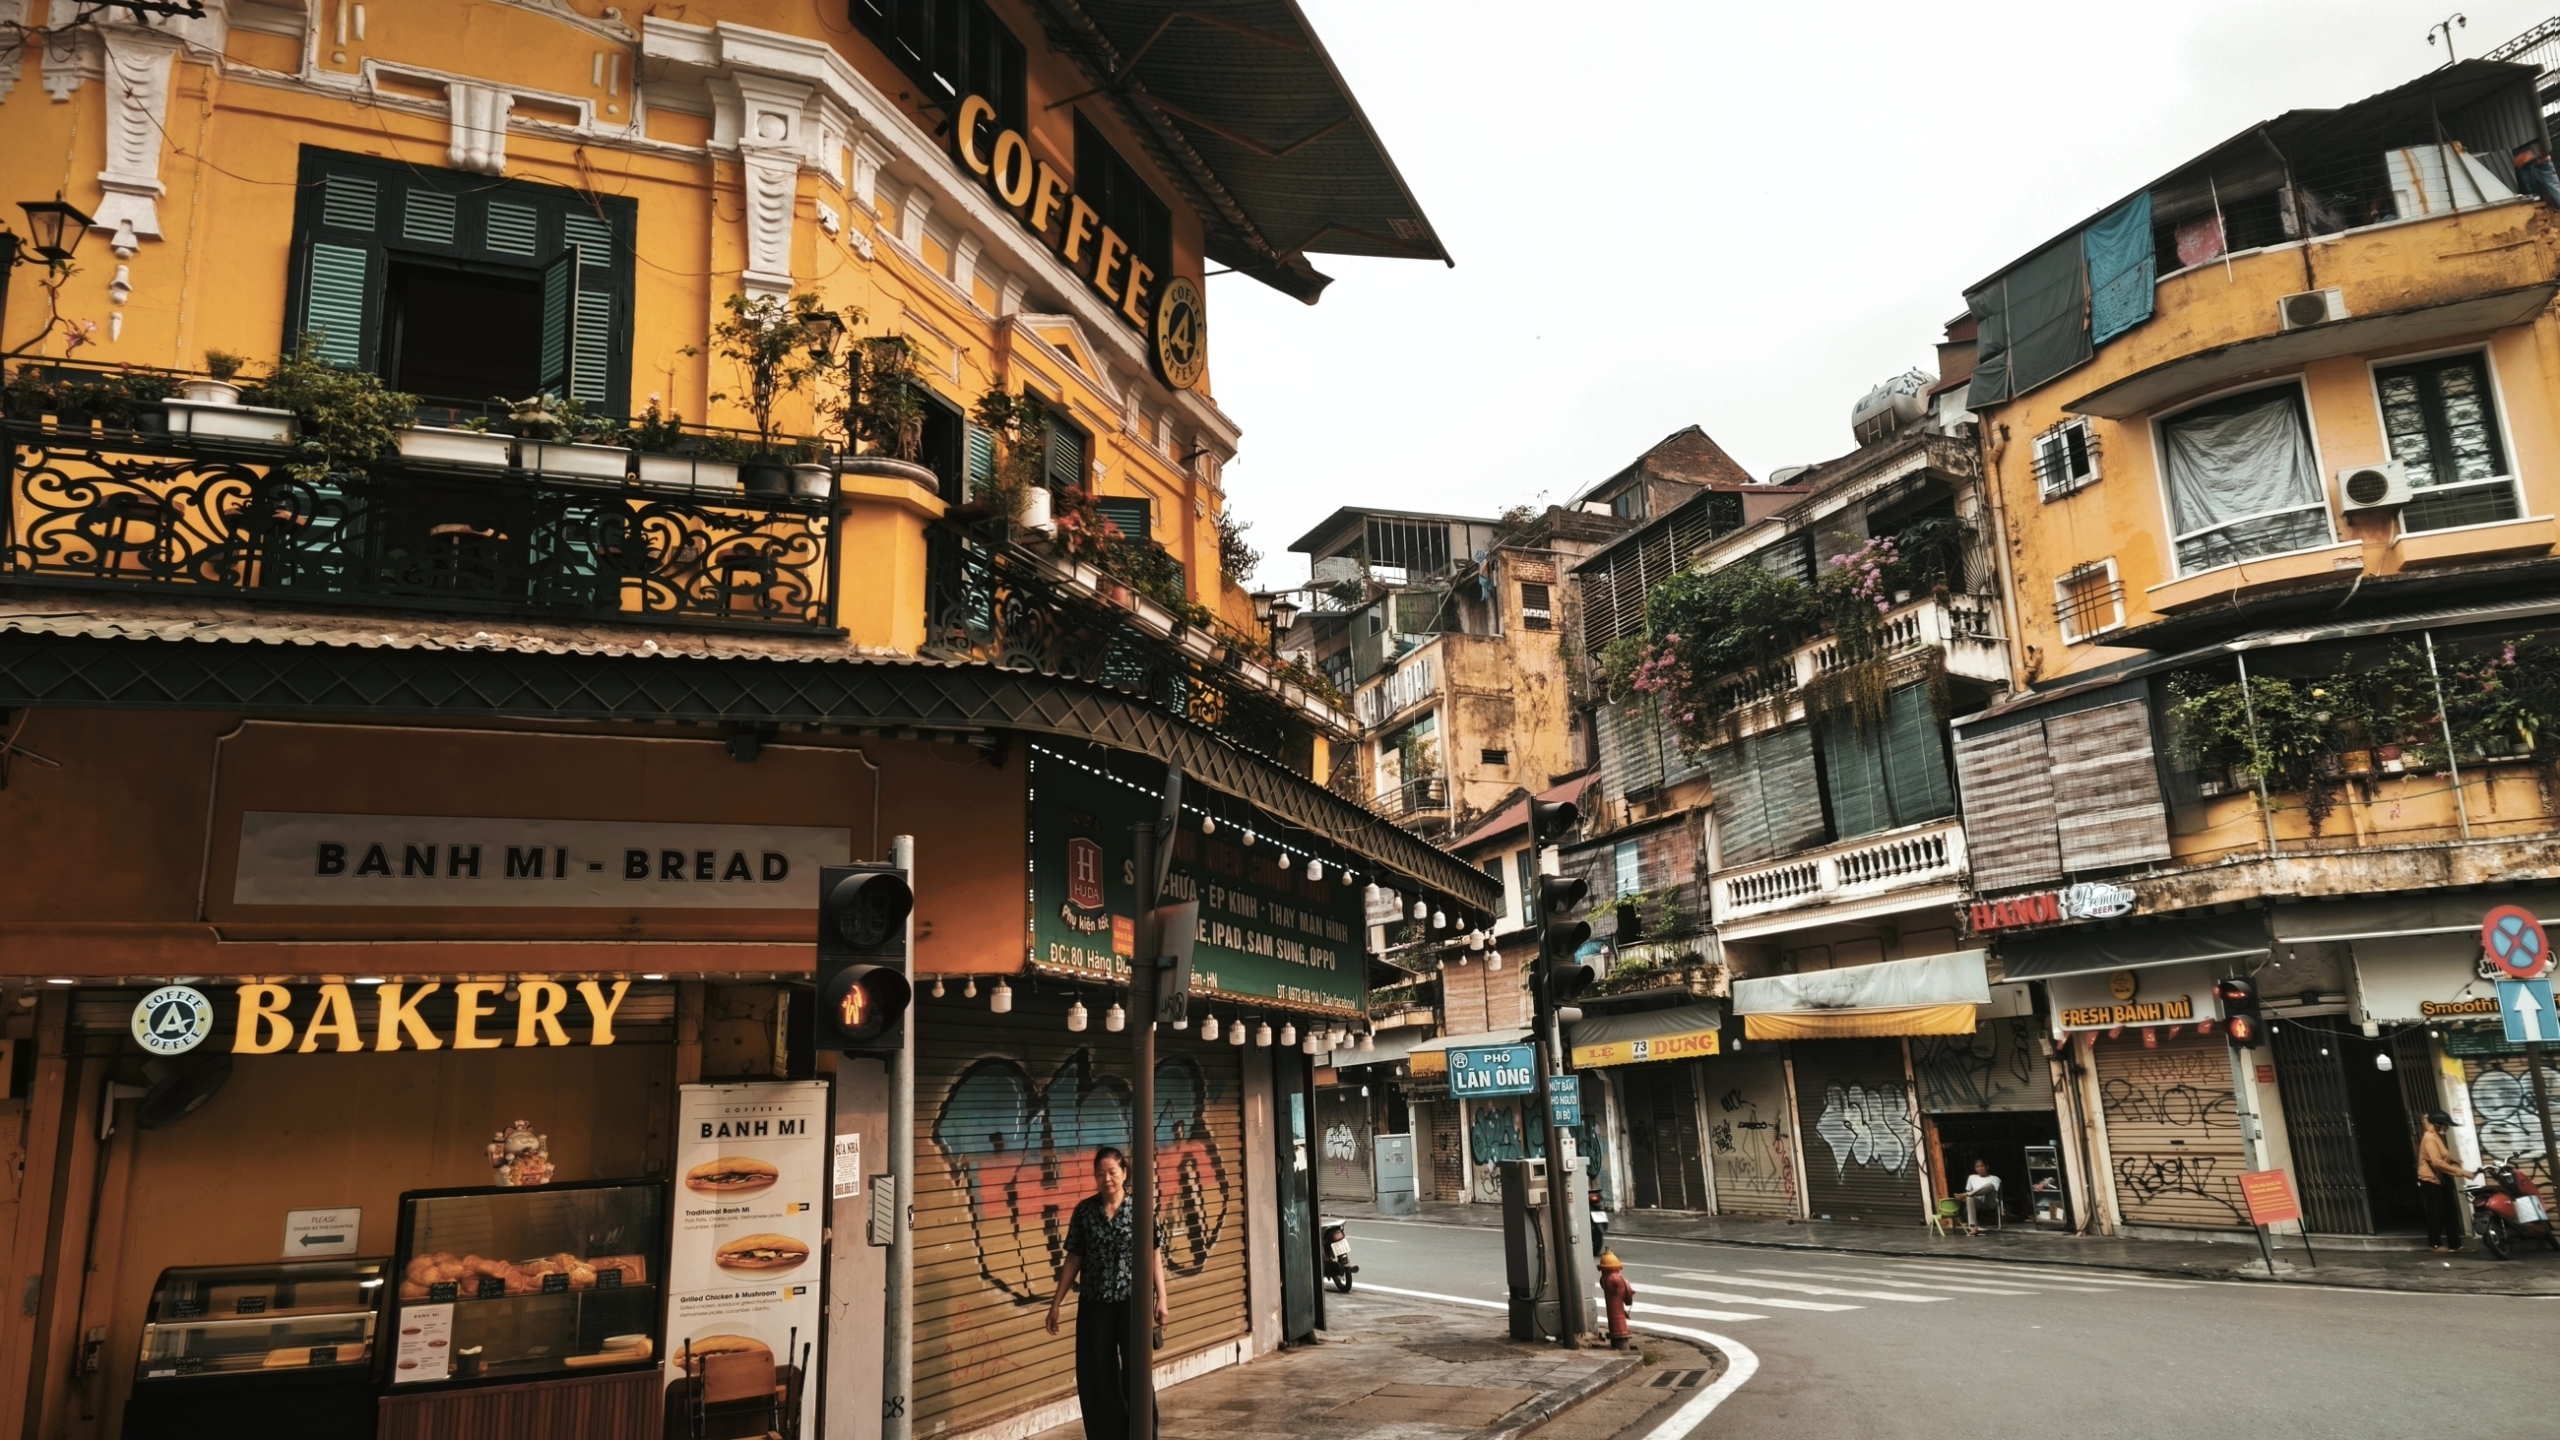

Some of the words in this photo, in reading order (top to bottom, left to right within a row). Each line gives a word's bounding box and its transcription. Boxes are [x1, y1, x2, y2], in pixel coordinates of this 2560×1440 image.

[958, 94, 1155, 328] COFFEE
[1172, 286, 1203, 331] COFFEE
[1161, 335, 1195, 380] COFFEE
[315, 841, 482, 879] BANH
[504, 845, 569, 881] MI
[587, 861, 604, 873] -
[623, 847, 791, 884] BREAD
[1074, 883, 1100, 900] HUDA
[1209, 879, 1225, 909] ÉP
[1229, 886, 1258, 919] KÍNH
[1268, 902, 1295, 929] THAY
[1299, 908, 1323, 937] MÀN
[1326, 915, 1348, 943] HÌNH
[1971, 893, 2060, 932] HANOI
[2070, 883, 2134, 914] Premium
[2092, 905, 2113, 915] BEER
[1062, 904, 1077, 930] Phụ
[1079, 915, 1096, 936] kiện
[1098, 913, 1110, 930] tốt
[1087, 950, 1112, 976] Hàng
[146, 991, 203, 1009] COFFEE
[2061, 1007, 2111, 1026] FRESH
[2114, 1000, 2161, 1022] BÁNH
[2165, 995, 2190, 1019] MÌ
[2422, 997, 2500, 1015] Smoothi
[231, 981, 632, 1054] BAKERY
[142, 1029, 202, 1050] COFFEE
[1588, 1046, 1614, 1059] LỆ
[1654, 1034, 1714, 1055] DUNG
[1633, 1041, 1647, 1053] 73
[1484, 1050, 1511, 1063] PHỐ
[1457, 1067, 1492, 1089] LÃN
[1495, 1065, 1530, 1086] ÔNG
[725, 1106, 773, 1114] COFFEE
[1551, 1096, 1559, 1105] HO
[701, 1120, 769, 1138] BANH
[778, 1119, 806, 1136] MI
[685, 1209, 722, 1217] Traditional
[680, 1295, 704, 1303] Grilled
[742, 1290, 777, 1298] Mushroom
